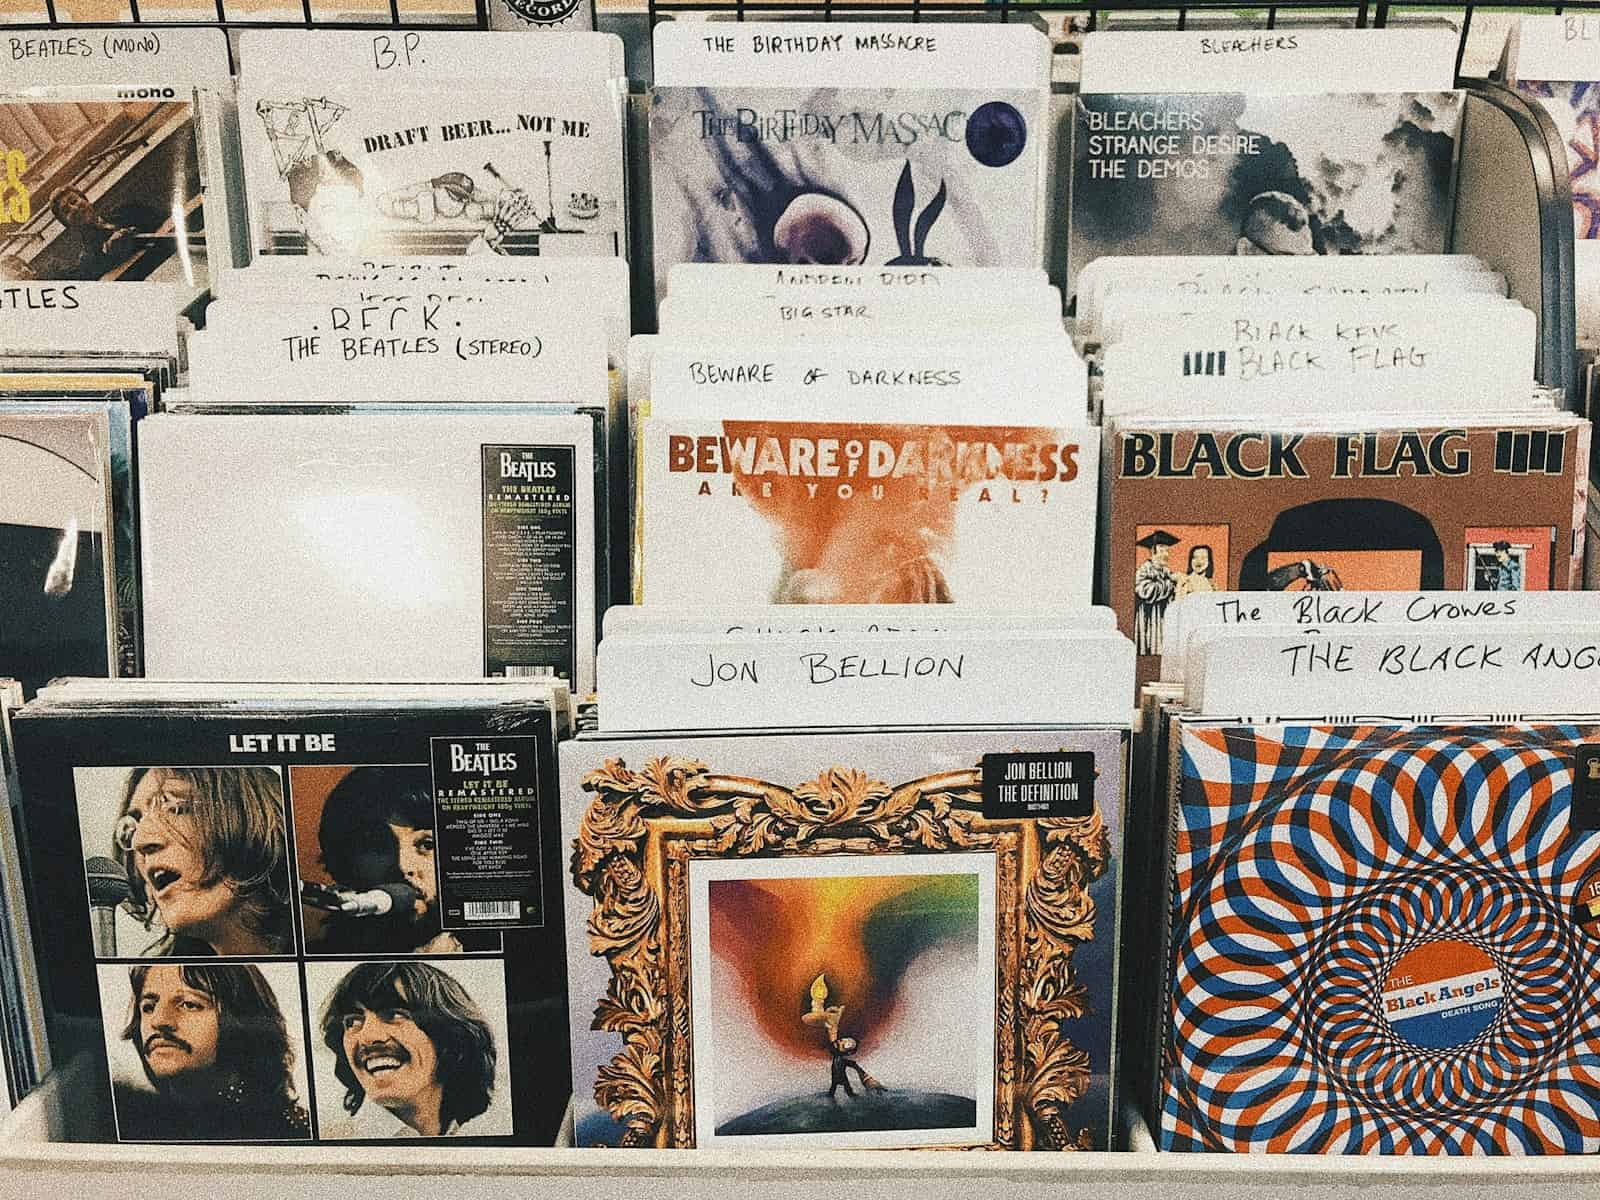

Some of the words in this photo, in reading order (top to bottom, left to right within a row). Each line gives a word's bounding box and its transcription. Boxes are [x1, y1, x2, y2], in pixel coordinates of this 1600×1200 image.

[1565, 15, 1594, 41] BL
[9, 38, 92, 60] BEATLES
[104, 32, 160, 58] (MONO)
[374, 33, 425, 69] B.P.
[703, 37, 735, 52] THE
[753, 35, 842, 53] BIRTHDAY
[856, 33, 936, 51] MASSACRE
[1201, 36, 1297, 54] BLEACHERS
[117, 87, 175, 99] mono
[851, 111, 966, 145] MASSAC
[1088, 111, 1204, 131] BLEACHERS
[364, 126, 429, 153] DRAFT
[517, 114, 556, 133] NOT
[561, 119, 590, 138] ME
[1088, 135, 1181, 155] STRANGE
[1193, 134, 1262, 155] DESIRE
[1088, 158, 1126, 179] THE
[1138, 158, 1210, 179] DEMOS
[0, 285, 79, 309] TLES
[780, 306, 813, 321] BIG
[821, 304, 872, 320] STAR
[282, 336, 320, 361] THE
[342, 336, 440, 361] BEATLES
[456, 335, 543, 361] (STEREO)
[688, 361, 775, 385] BEWARE
[803, 370, 828, 386] OF
[848, 369, 962, 387] DARKNESS
[1238, 346, 1325, 381] BLACK
[1350, 345, 1430, 374] FLAG
[521, 451, 534, 461] THE
[668, 434, 841, 478] BEWARE
[844, 438, 865, 478] OF
[866, 437, 1080, 483] DARKNESS
[1120, 431, 1308, 480] BLACK
[1332, 428, 1472, 478] FLAG
[500, 452, 557, 482] BEATLES
[698, 480, 773, 498] ARE
[808, 483, 884, 501] YOU
[1216, 599, 1261, 622] The
[1293, 596, 1383, 624] Black
[1406, 597, 1517, 622] Crowes
[691, 653, 758, 687] JON
[800, 652, 963, 684] BELLION
[1281, 645, 1353, 676] THE
[1378, 644, 1502, 675] BLACK
[1521, 643, 1600, 670] ANG
[229, 734, 273, 753] LET
[276, 734, 301, 753] IT
[304, 733, 337, 752] BE
[475, 742, 490, 751] THE
[450, 743, 518, 776] BEATLES
[1004, 762, 1026, 781] JON
[1029, 761, 1073, 780] BELLION
[437, 787, 535, 798] REMASTERED
[463, 780, 480, 790] LET
[482, 780, 492, 789] IT
[495, 779, 509, 789] BE
[998, 785, 1018, 803] THE
[1020, 783, 1079, 802] DEFINITION
[1390, 975, 1414, 989] THE
[1385, 991, 1437, 1012] Black
[1438, 977, 1500, 1000] Angels
[1441, 1006, 1471, 1018] DEATH
[1472, 1000, 1498, 1013] SONG
